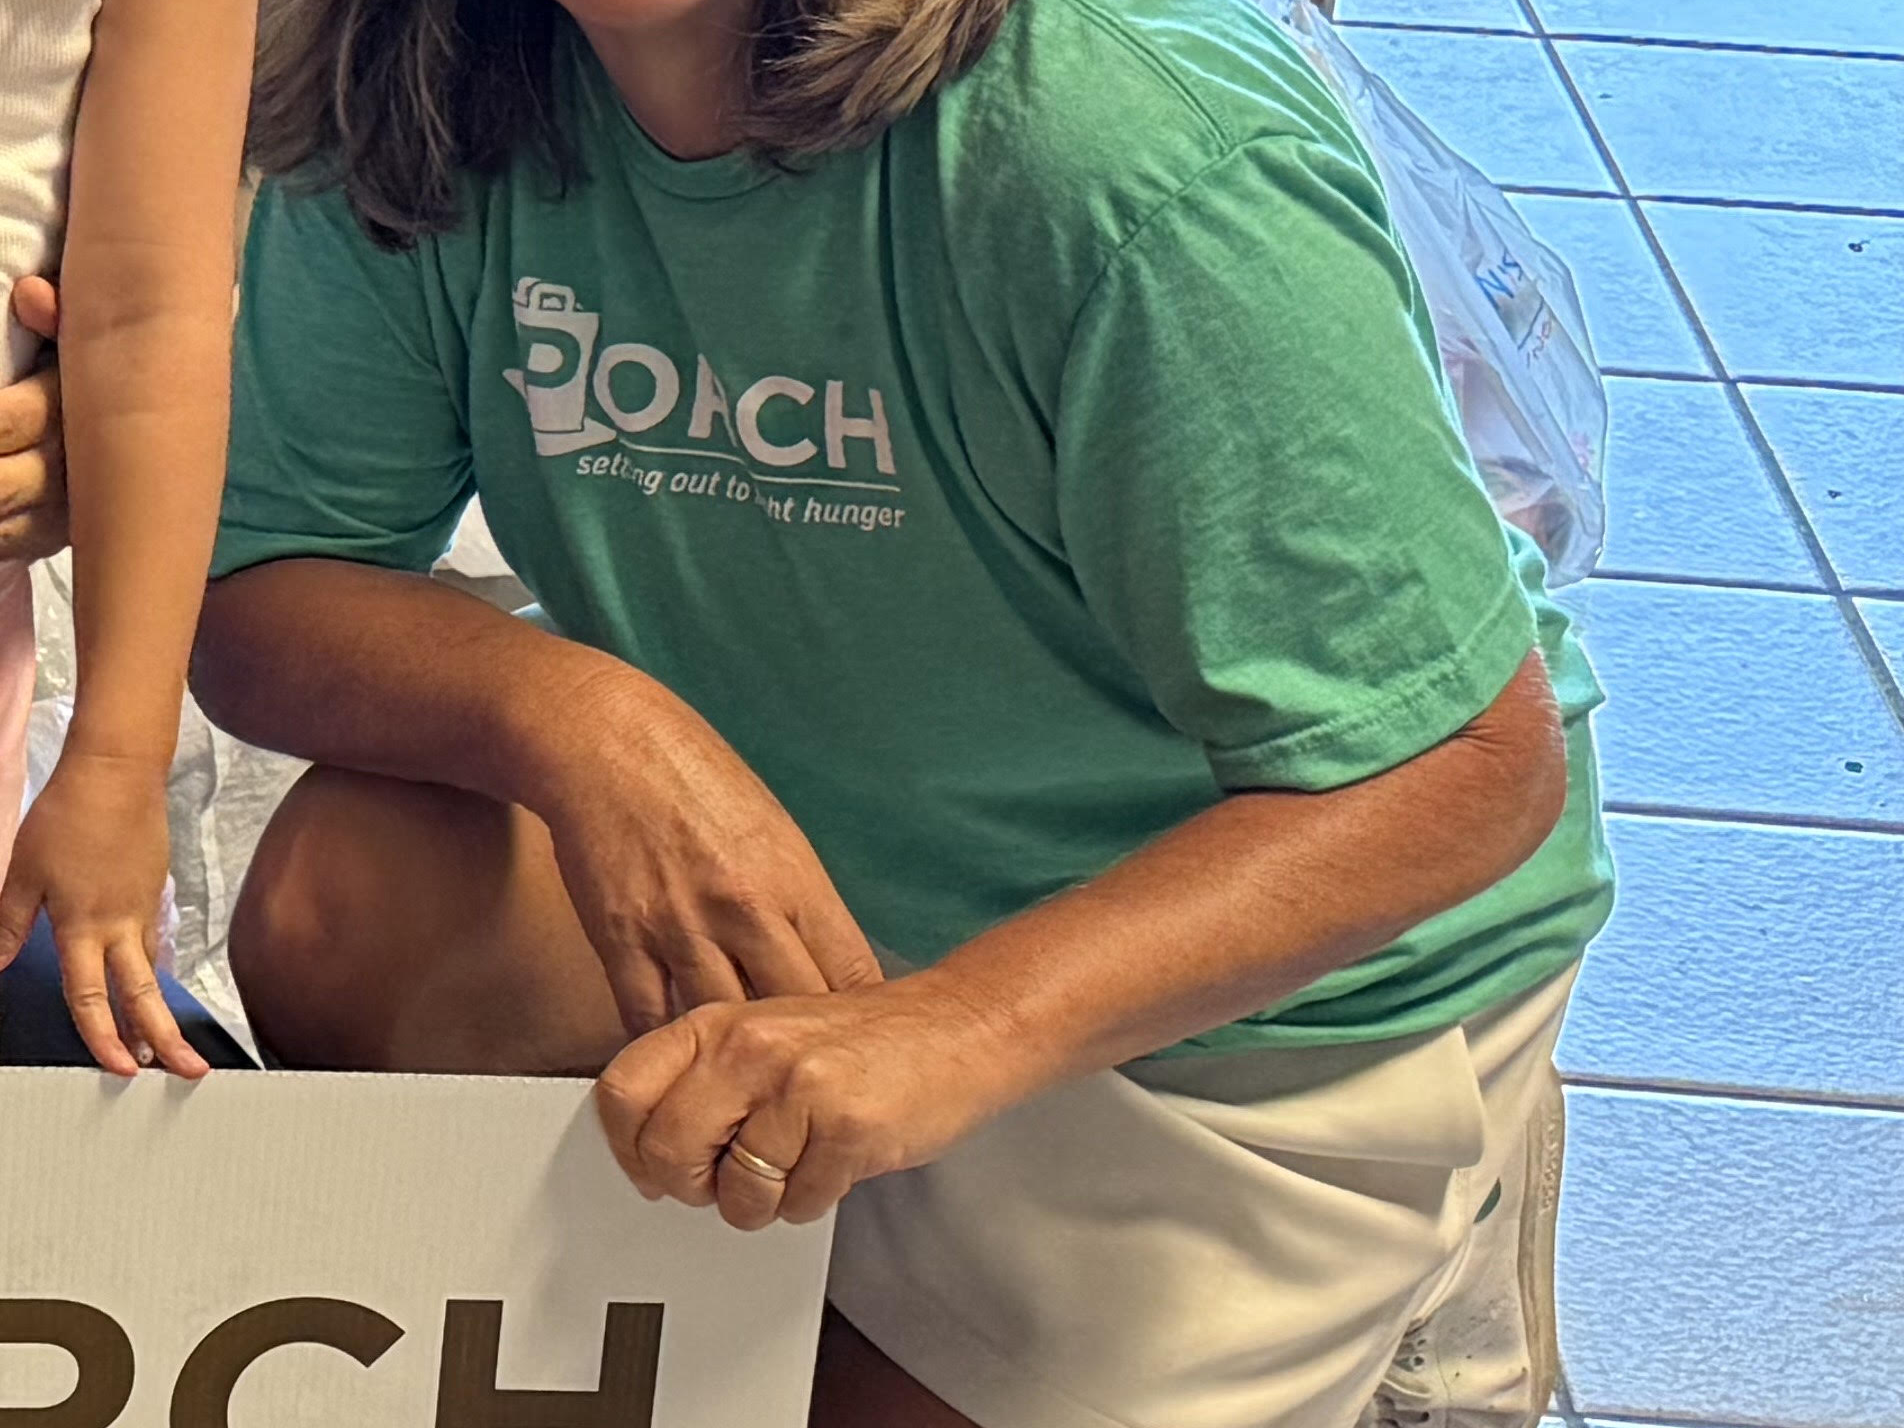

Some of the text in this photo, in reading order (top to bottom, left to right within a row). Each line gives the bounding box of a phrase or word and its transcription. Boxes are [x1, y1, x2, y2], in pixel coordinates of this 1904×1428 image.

[669, 471, 721, 497] out
[726, 476, 751, 502] to
[803, 496, 906, 532] hunger
